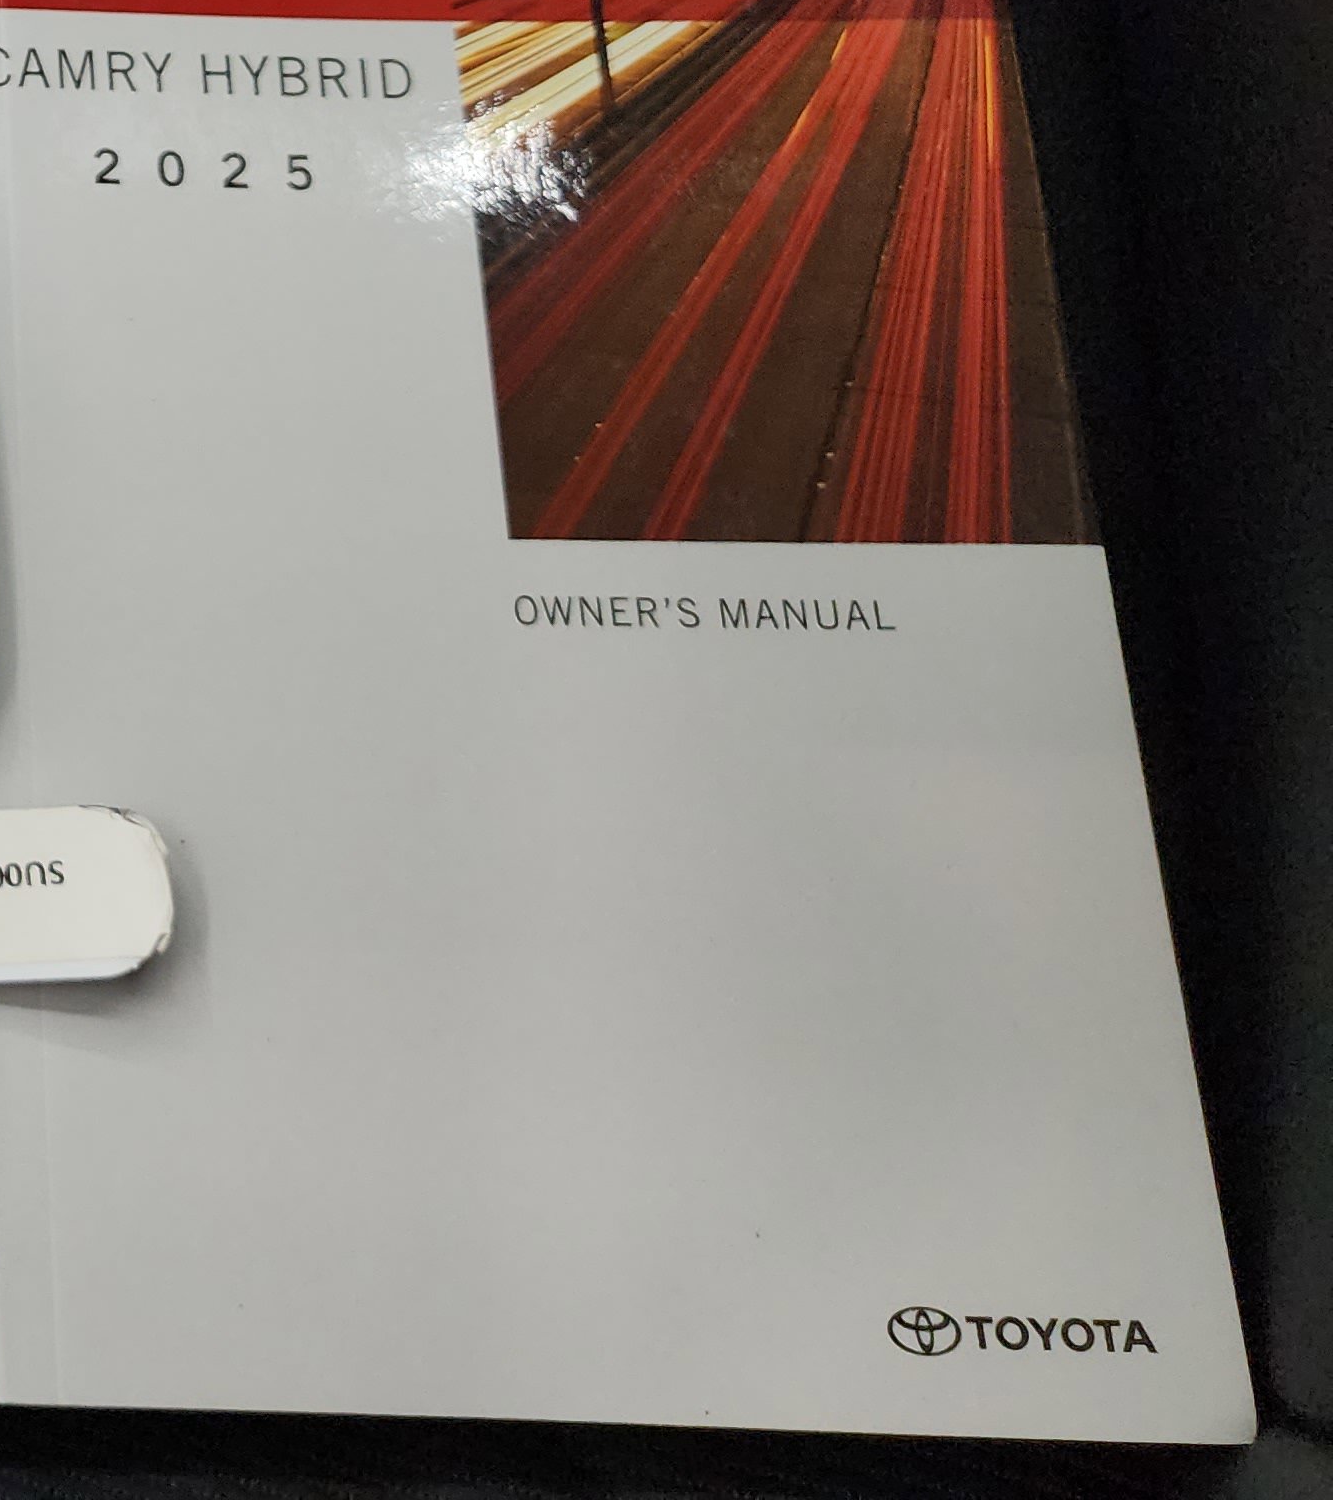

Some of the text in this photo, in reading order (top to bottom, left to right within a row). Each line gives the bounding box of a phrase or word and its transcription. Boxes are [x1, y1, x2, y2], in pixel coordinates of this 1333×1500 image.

[199, 53, 413, 100] HYBRID
[513, 594, 897, 632] OWNER'S MANUAL
[964, 1315, 1159, 1354] TOYOTA
